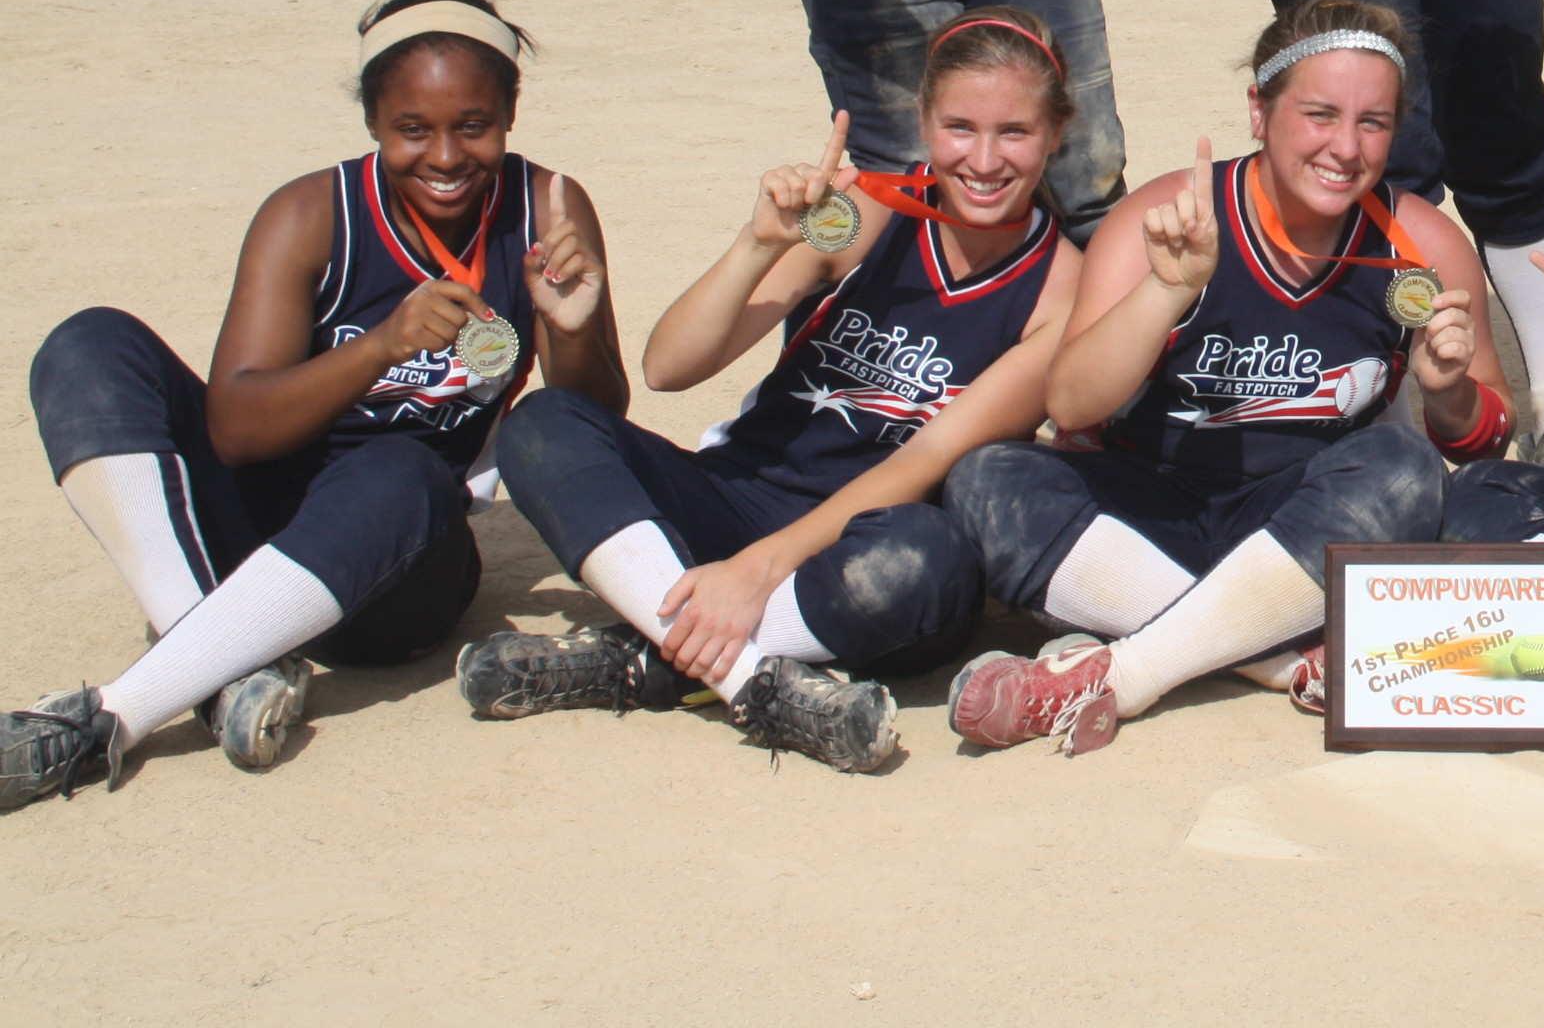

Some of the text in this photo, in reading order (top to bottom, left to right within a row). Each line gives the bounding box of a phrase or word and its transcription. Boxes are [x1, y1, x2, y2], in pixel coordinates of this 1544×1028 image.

[829, 308, 954, 394] Pride
[1196, 334, 1321, 383] Pride
[386, 366, 430, 385] PITCH
[839, 354, 921, 401] FASTPITCH
[1213, 380, 1298, 397] FASTPITCH
[1351, 608, 1506, 676] 1ST PLACE 16U
[1368, 628, 1516, 693] CHAMPIONSHIP
[1391, 694, 1526, 716] CLASSIC
